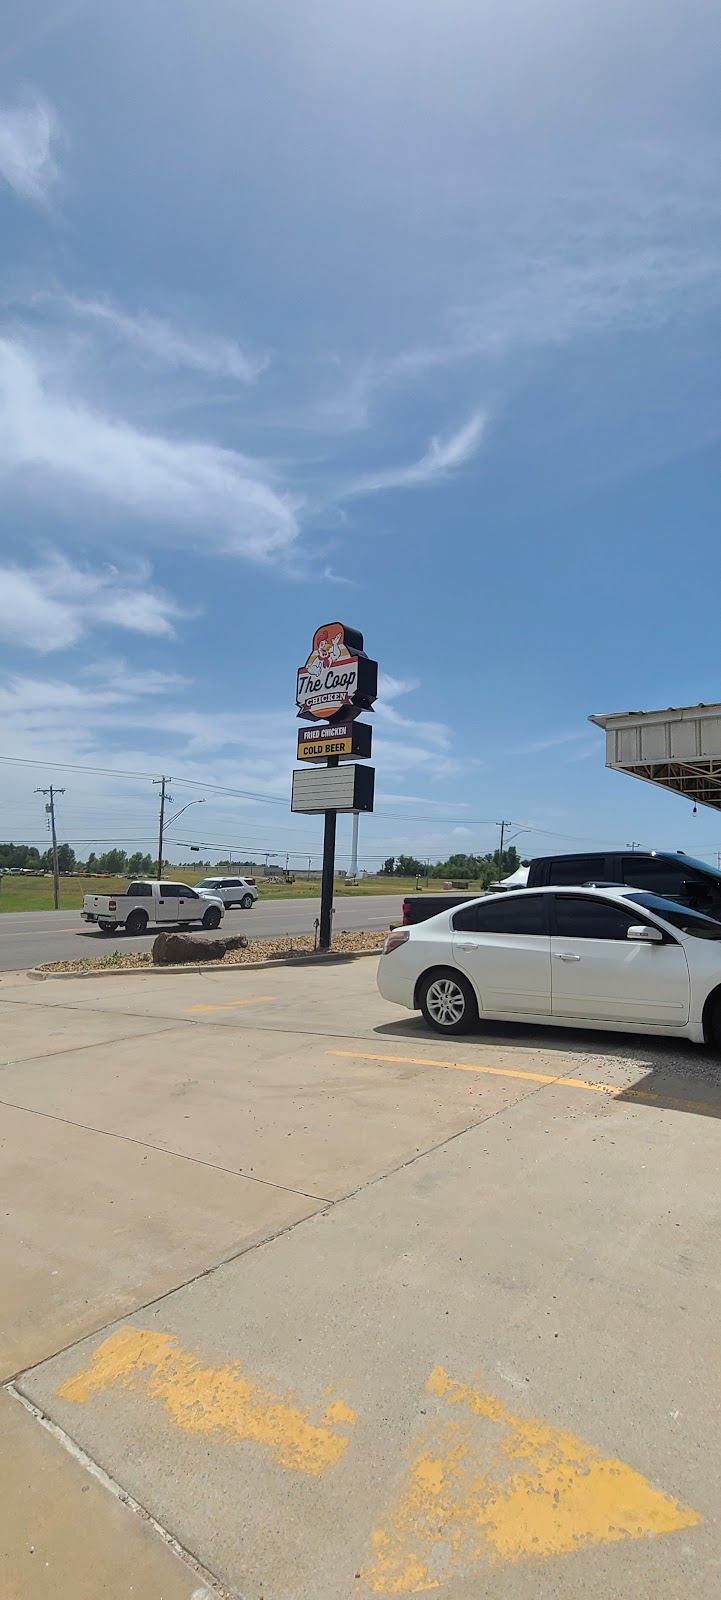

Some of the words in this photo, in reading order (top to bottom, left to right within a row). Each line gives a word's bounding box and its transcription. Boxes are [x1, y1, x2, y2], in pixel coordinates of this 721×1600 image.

[299, 676, 323, 694] The
[325, 671, 356, 690] Coop
[306, 693, 347, 706] CHICKEN
[304, 730, 320, 740] FRIED
[321, 726, 347, 737] CHICKEN
[303, 746, 323, 755] COLD
[325, 743, 345, 752] BEER
